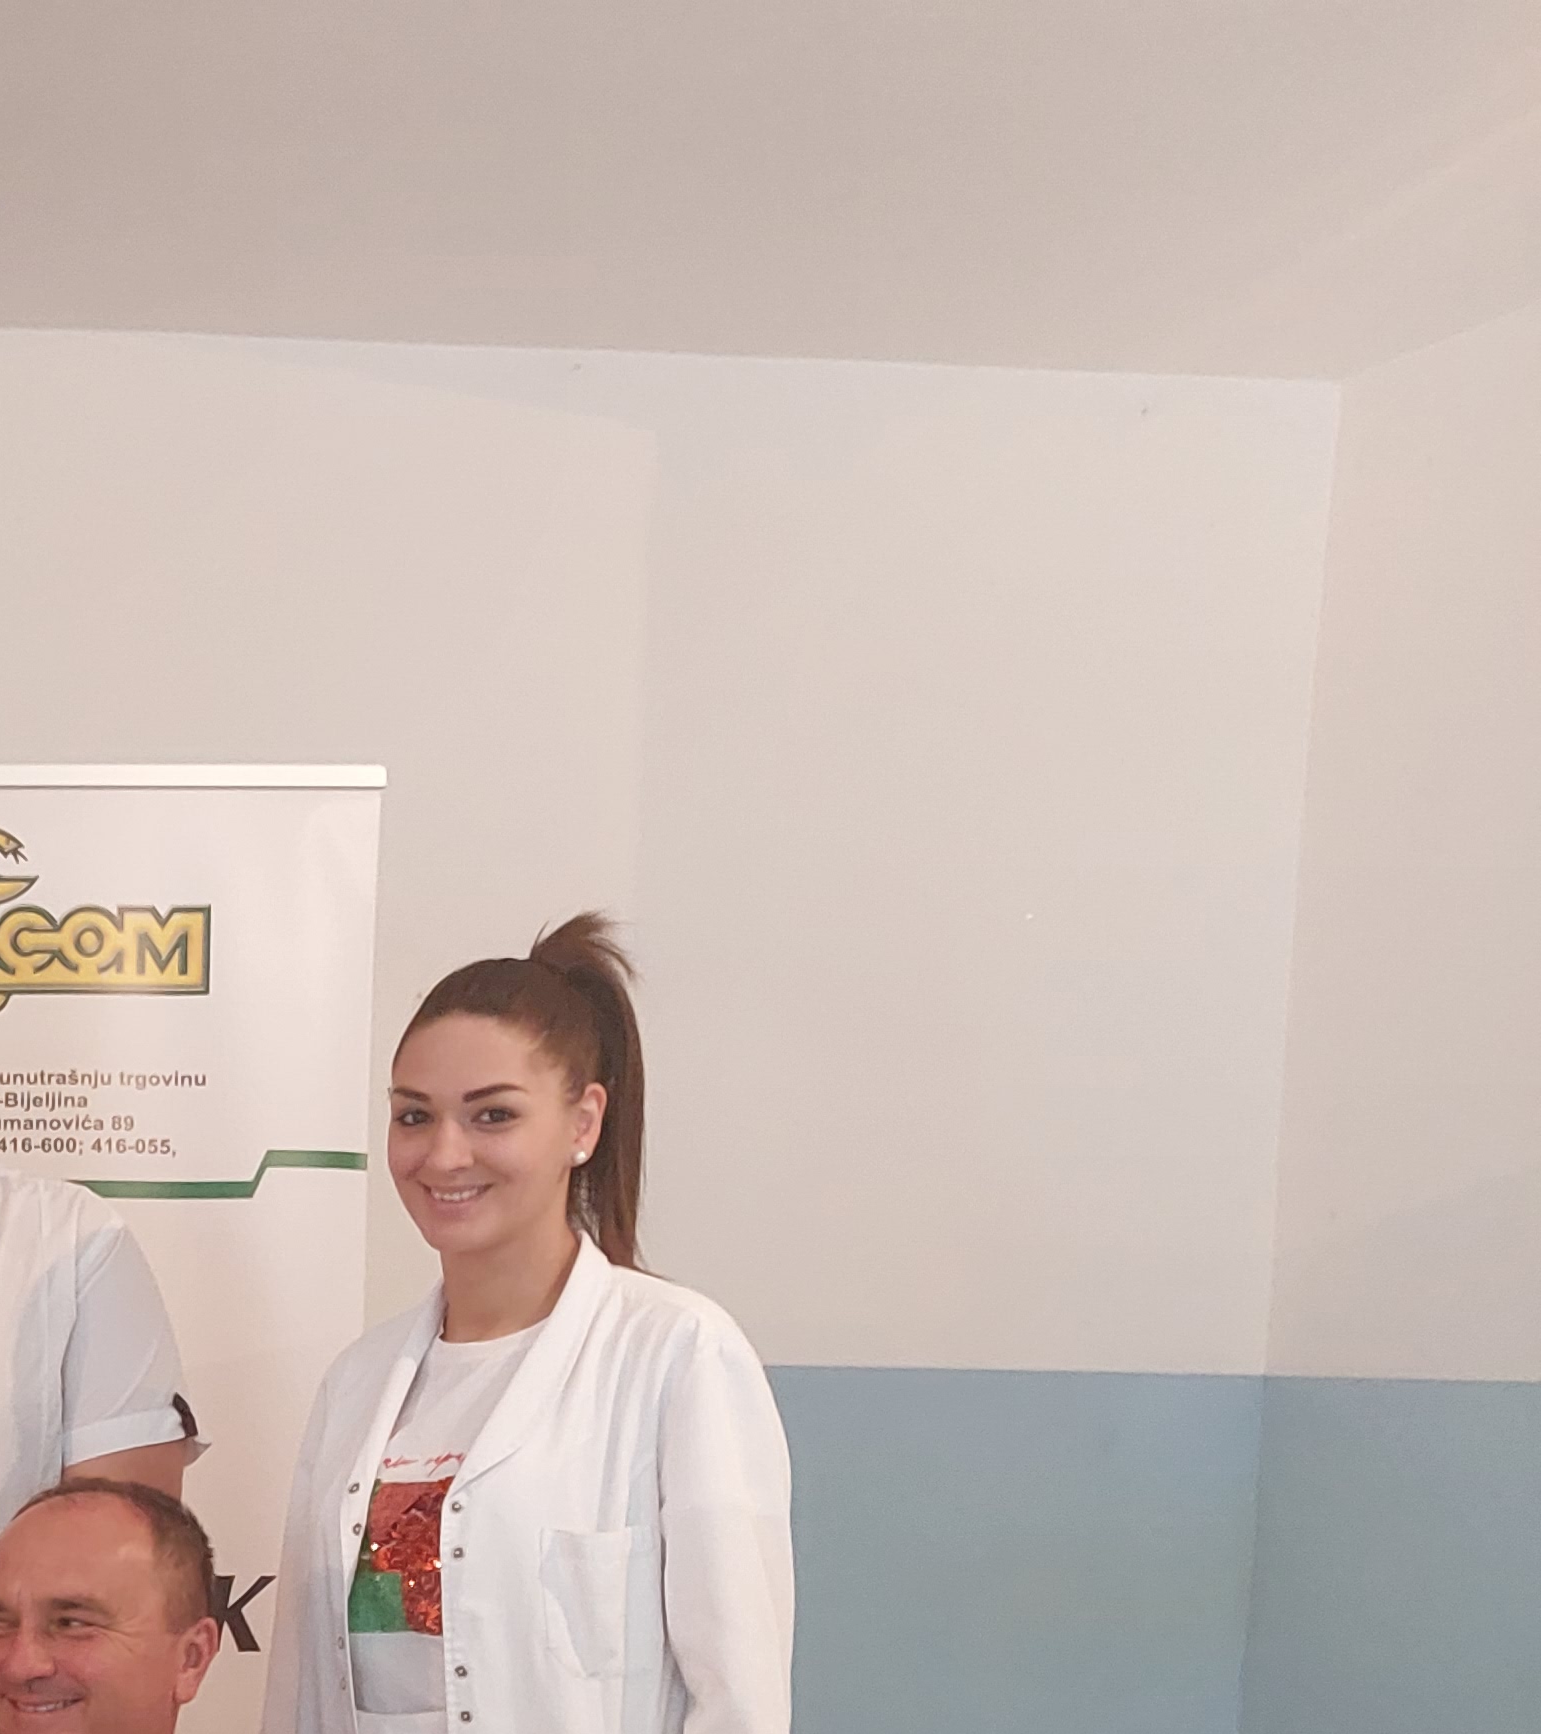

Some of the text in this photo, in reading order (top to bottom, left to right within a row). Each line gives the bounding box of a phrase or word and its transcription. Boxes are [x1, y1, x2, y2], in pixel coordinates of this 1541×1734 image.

[0, 1069, 112, 1089] unutrašnju
[119, 1070, 207, 1090] trgovinu
[111, 1115, 135, 1132] 89
